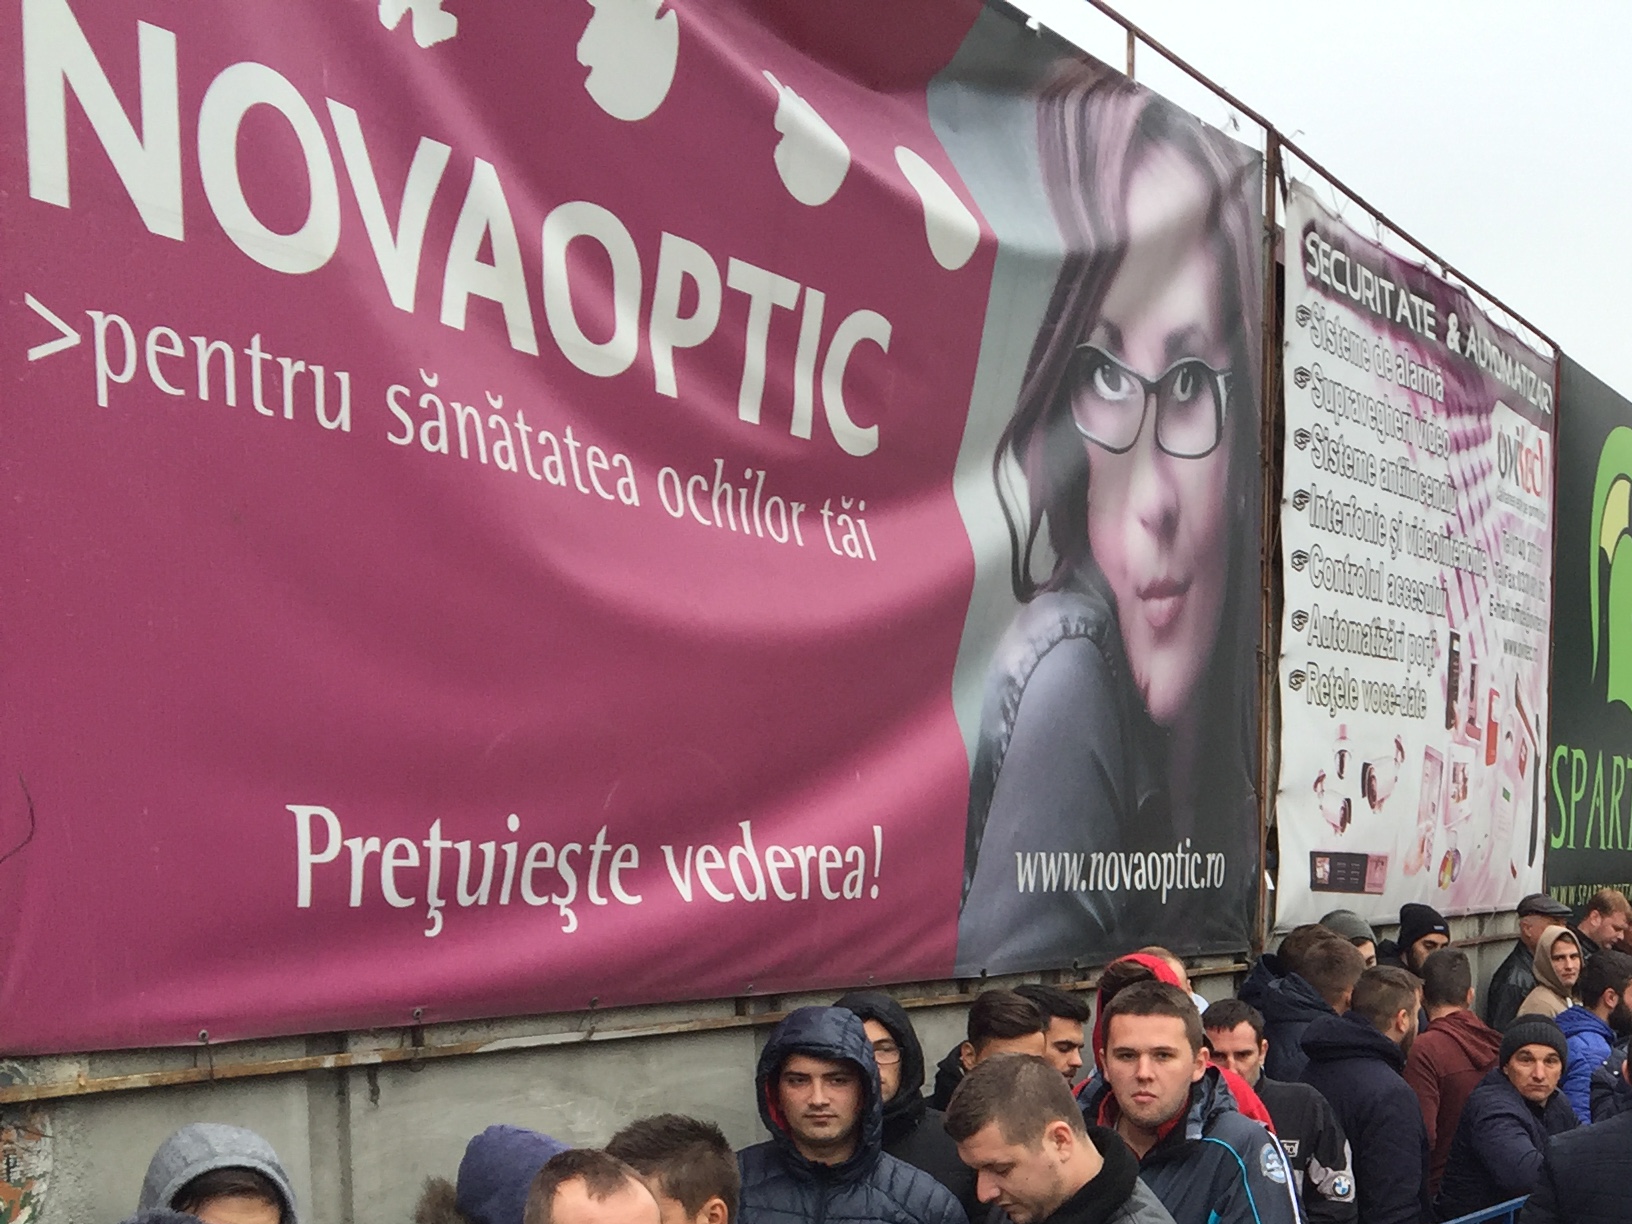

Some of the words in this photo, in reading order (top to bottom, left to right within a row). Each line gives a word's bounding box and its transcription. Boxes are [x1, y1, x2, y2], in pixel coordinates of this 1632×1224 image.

[22, 0, 893, 457] NOVAOPTIC
[1304, 231, 1437, 341] SECURITATE
[1446, 312, 1461, 354] &
[1310, 301, 1371, 373] Sisteme
[1373, 335, 1393, 383] de
[1310, 361, 1412, 445] Supravegheri
[1415, 410, 1451, 461] video
[386, 368, 641, 509] sănătatea
[657, 458, 806, 549] ochilor
[820, 495, 878, 563] tăi
[1310, 423, 1377, 487] Sisteme
[1308, 482, 1387, 548] Interfonie
[1308, 543, 1385, 603] Controlul
[1386, 572, 1447, 619] accesului
[1361, 677, 1427, 719] voce-date
[660, 820, 884, 905] vederea!
[1015, 837, 1226, 904] www.novaoptic.ro
